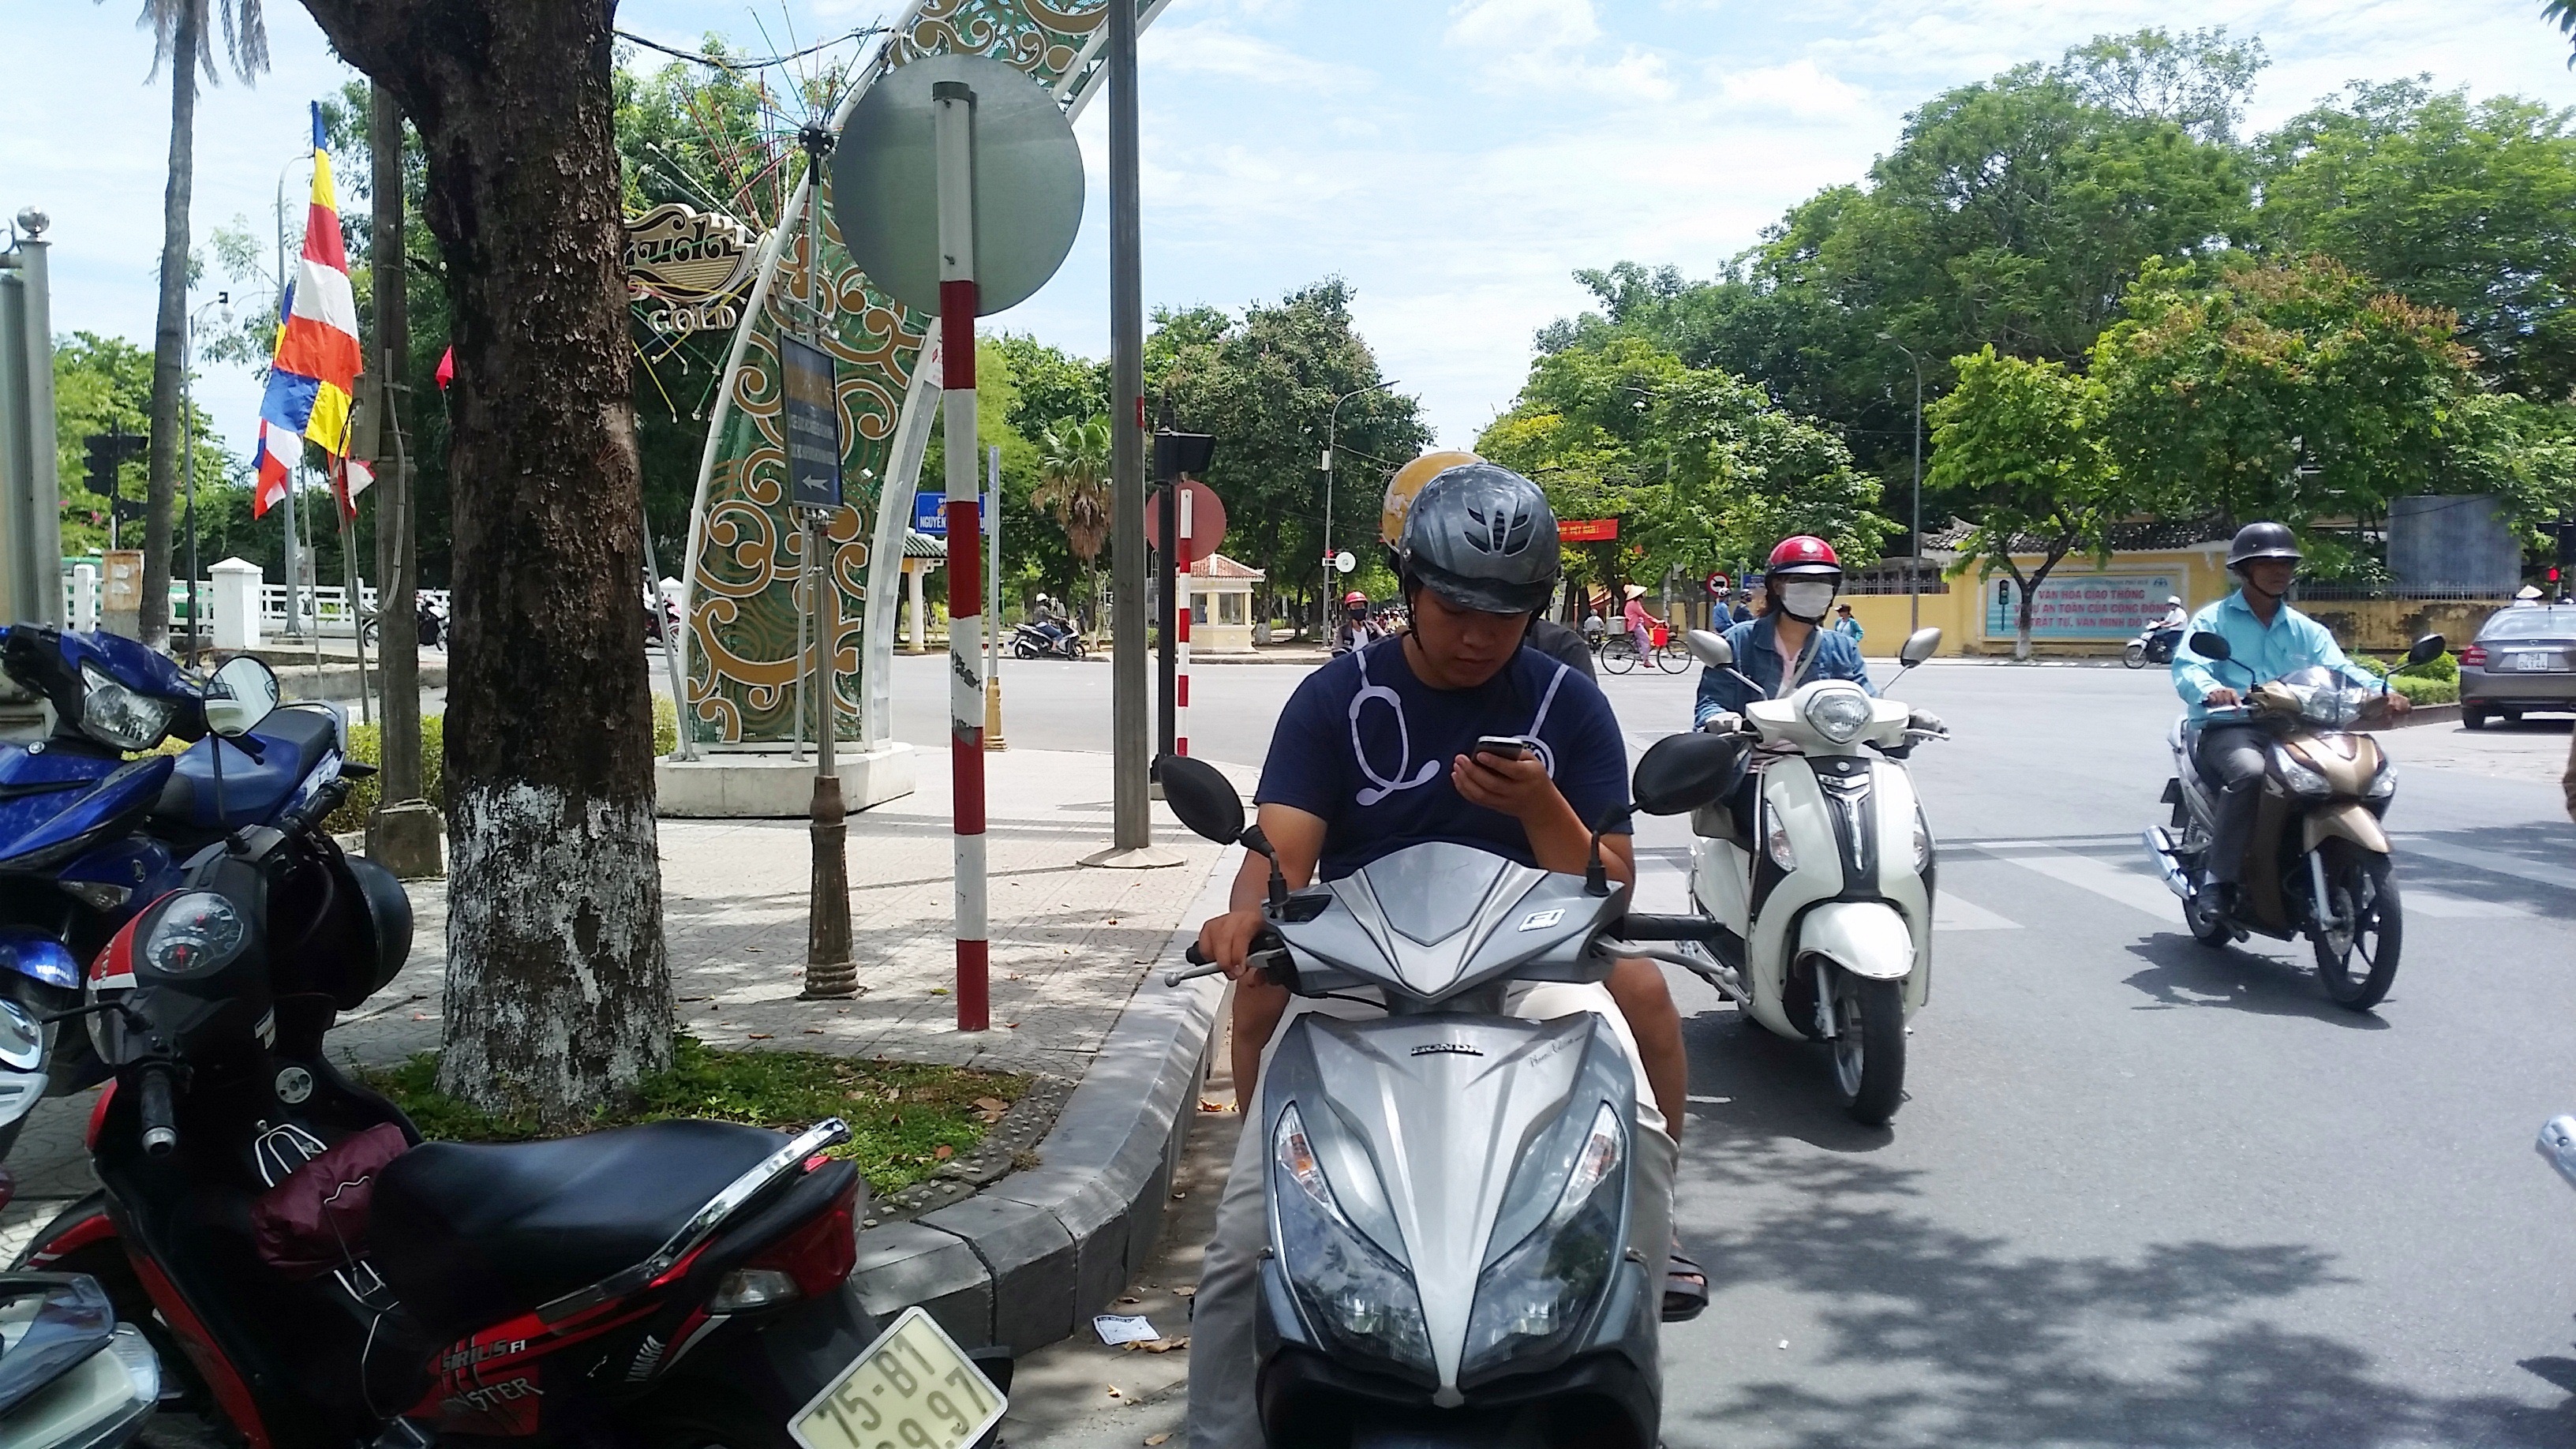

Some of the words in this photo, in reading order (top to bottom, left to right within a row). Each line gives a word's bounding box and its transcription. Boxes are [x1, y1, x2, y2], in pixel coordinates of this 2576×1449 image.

[648, 305, 736, 333] GOLD
[2084, 590, 2108, 599] GIAO
[2110, 588, 2145, 599] THÔNG
[2099, 618, 2125, 627] MINH
[35, 964, 70, 981] YAMAHA
[1411, 1043, 1484, 1056] HONDA
[442, 1339, 507, 1372] SIRIUS
[509, 1339, 526, 1354] FI
[624, 1335, 666, 1382] YAMAHA
[814, 1333, 935, 1448] 75-B1
